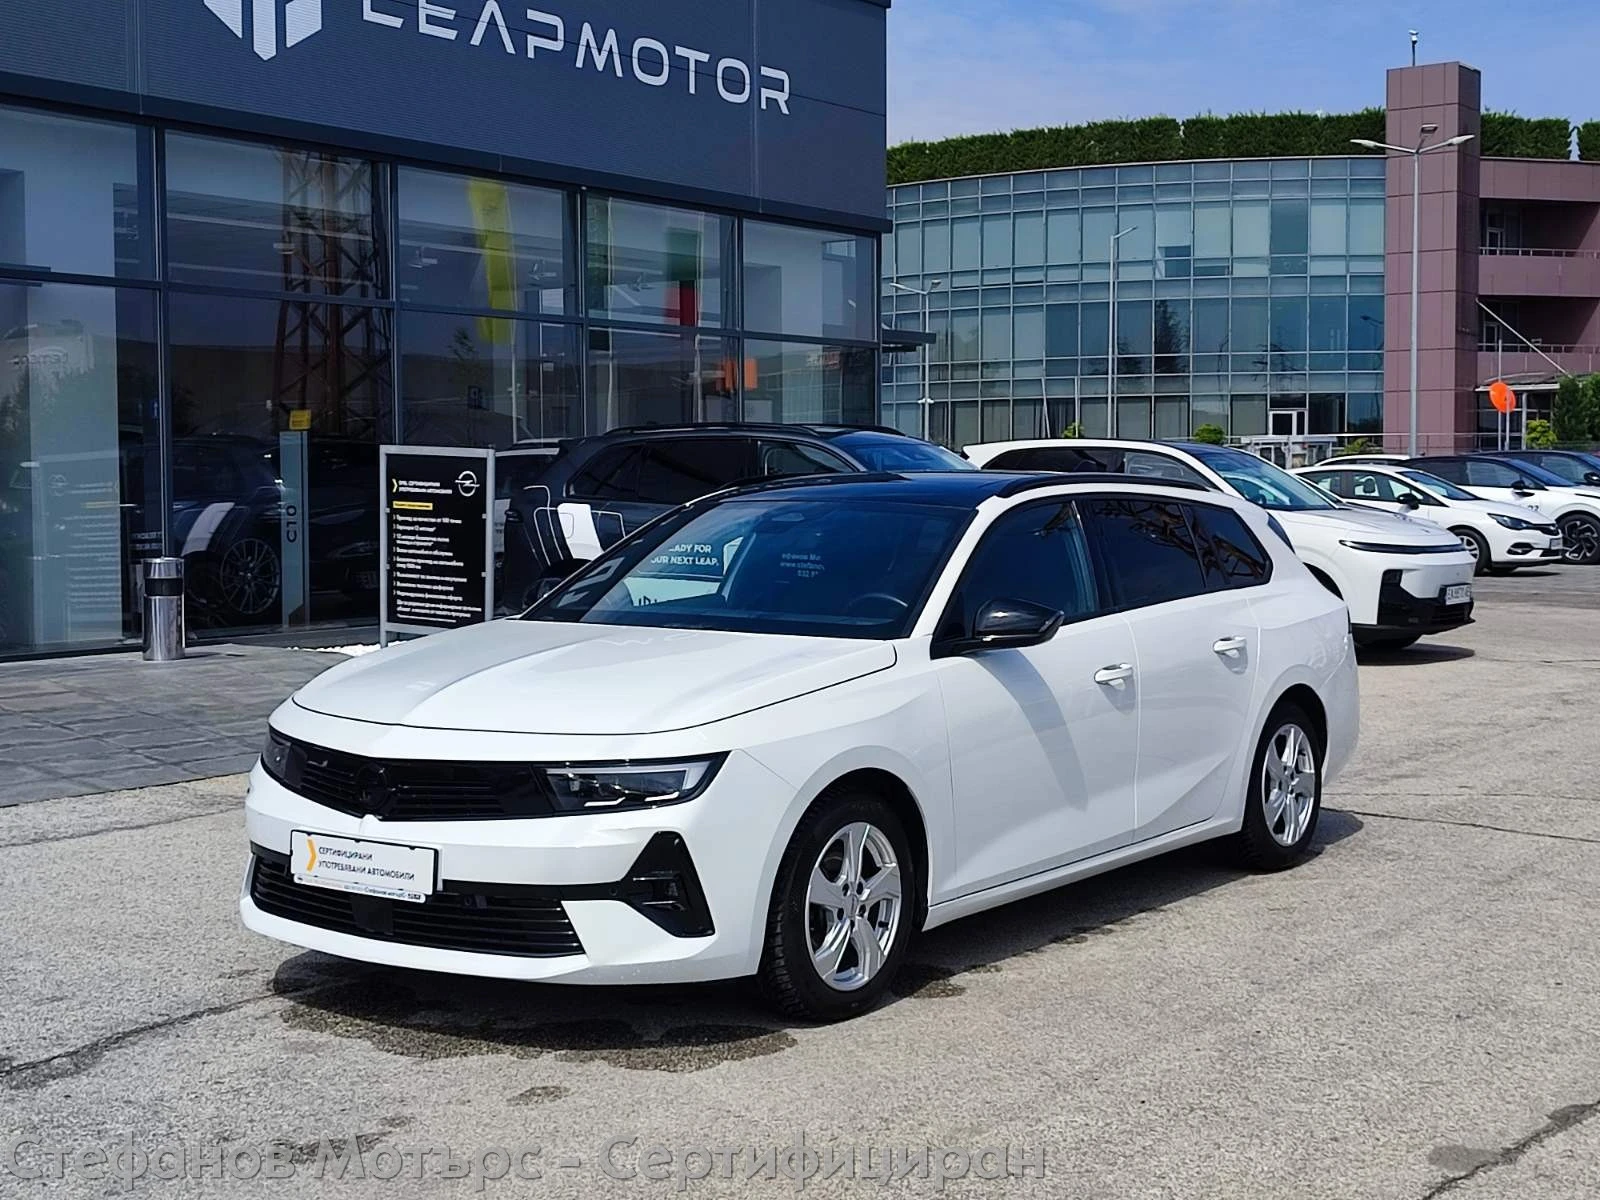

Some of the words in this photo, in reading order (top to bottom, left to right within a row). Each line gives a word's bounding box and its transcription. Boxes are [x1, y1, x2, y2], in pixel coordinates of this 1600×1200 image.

[362, 0, 790, 115] LEAPMOTOR
[286, 504, 298, 543] C10
[694, 544, 712, 553] FOR
[670, 556, 693, 565] NEXT
[695, 556, 720, 566] LEAP.
[318, 846, 373, 860] СЕРТИФИЦИРАНИ
[318, 860, 366, 873] УПОТРЕБЯВАНИ
[367, 867, 415, 881] АВТОМОБИЛИ
